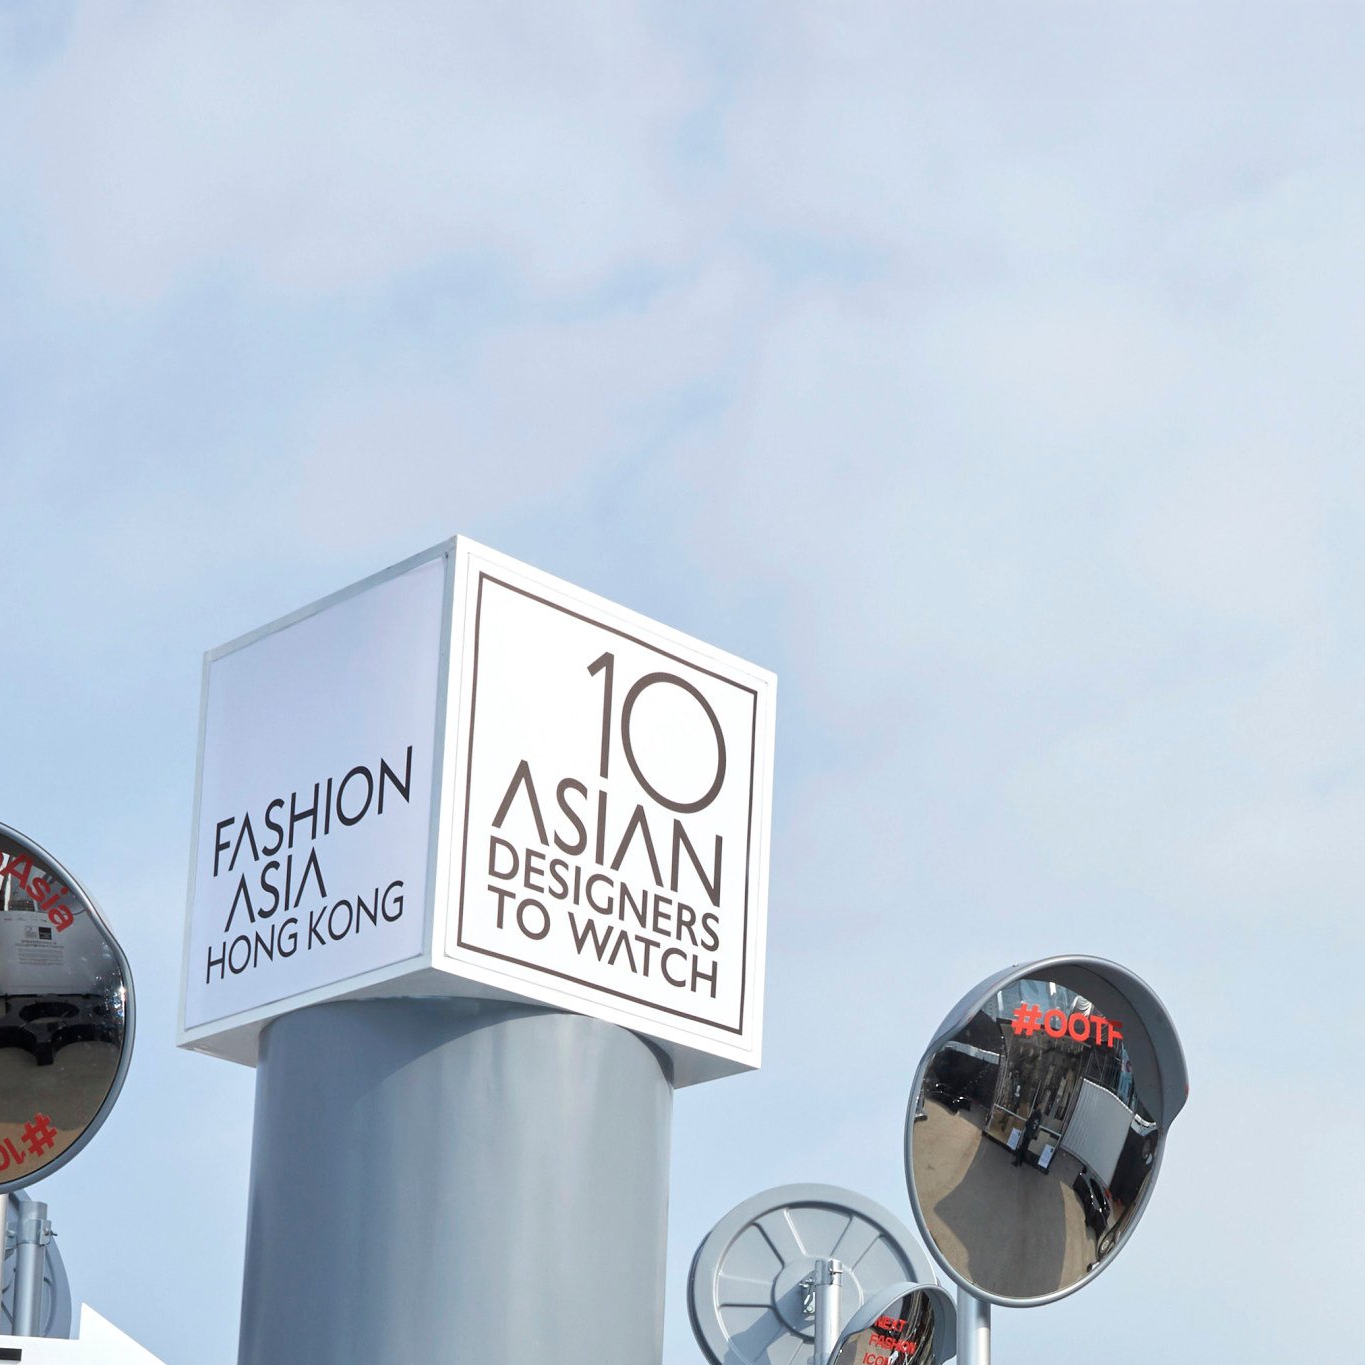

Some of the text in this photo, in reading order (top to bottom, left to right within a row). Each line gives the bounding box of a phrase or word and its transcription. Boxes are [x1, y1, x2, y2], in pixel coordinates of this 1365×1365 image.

[586, 651, 727, 815] 10
[213, 745, 414, 878] FASHION
[491, 758, 724, 908] ASIAN
[206, 880, 404, 985] HONG KONG
[224, 846, 327, 932] ASIA
[487, 835, 721, 952] DESIGNERS
[487, 884, 718, 999] TO WATCH
